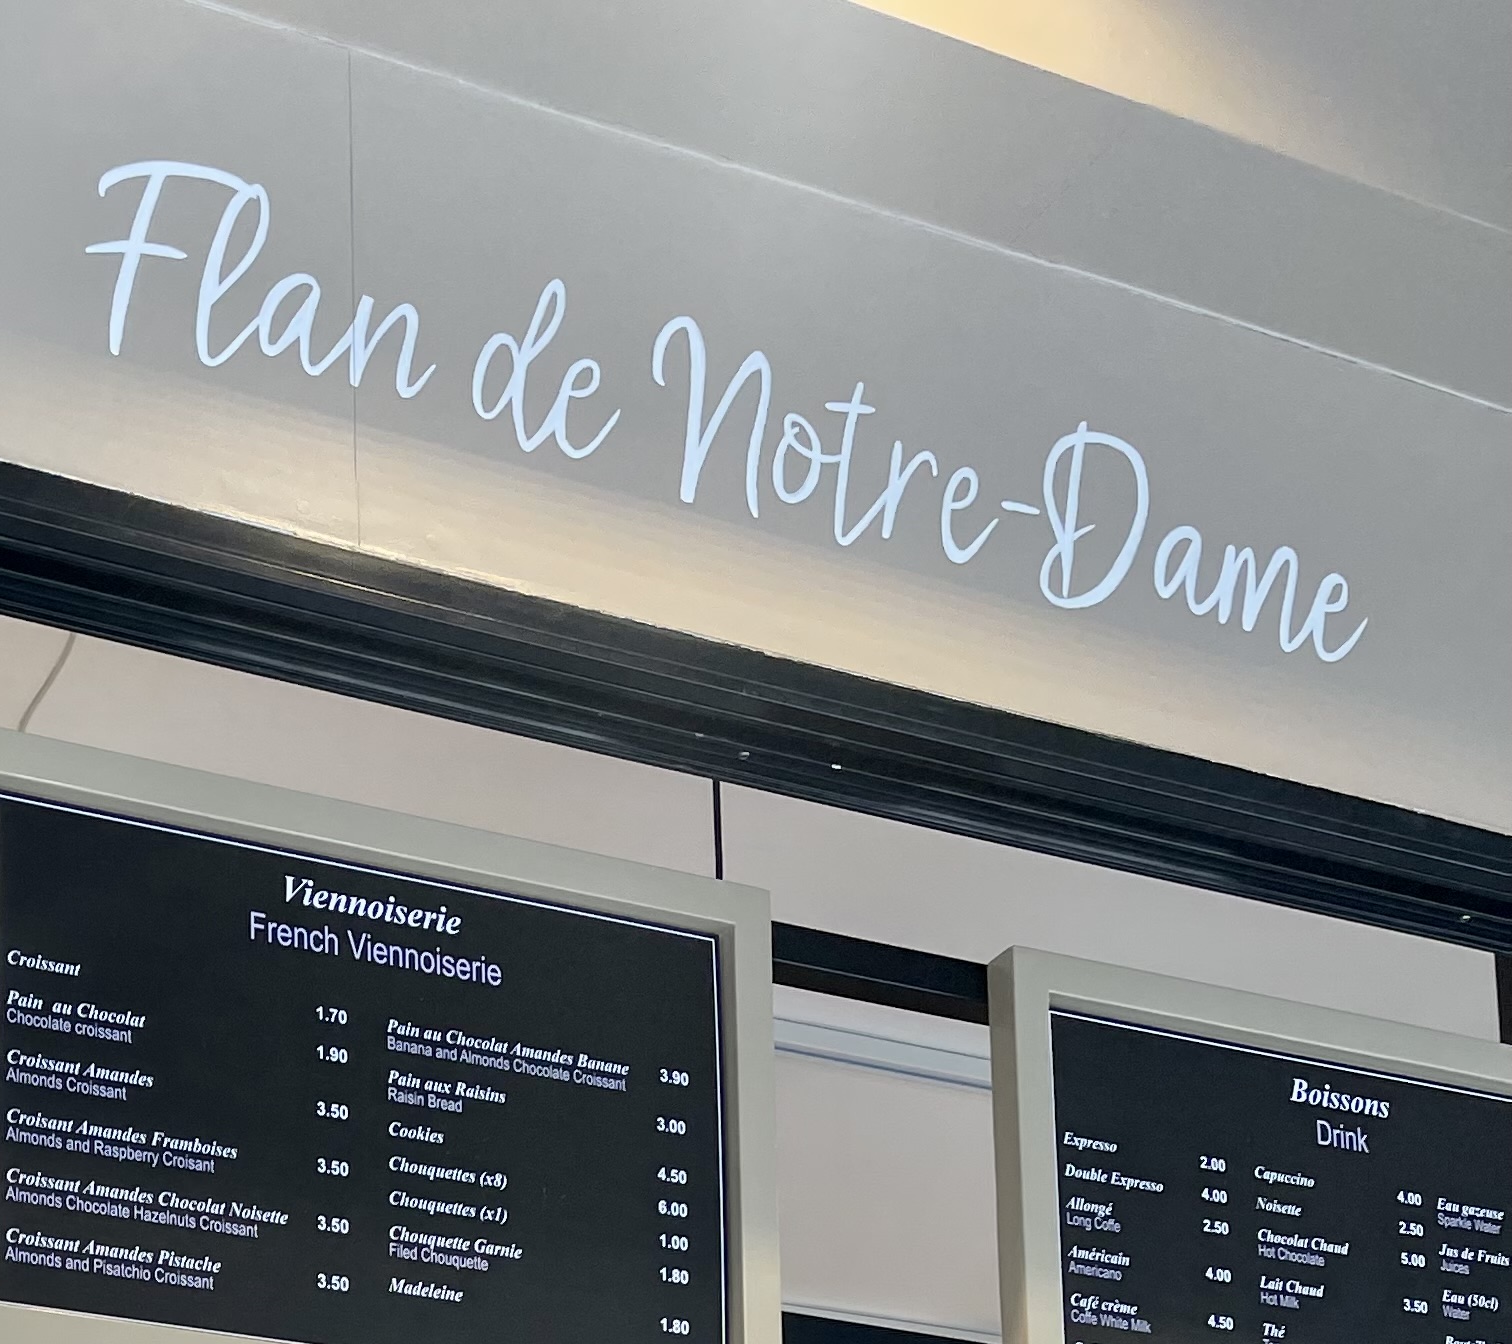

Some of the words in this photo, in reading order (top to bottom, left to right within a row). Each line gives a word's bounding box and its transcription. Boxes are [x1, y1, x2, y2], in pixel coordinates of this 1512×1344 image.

[85, 160, 437, 399] Flan
[473, 278, 620, 459] de
[652, 316, 1368, 662] Notre-Dame
[284, 874, 461, 935] Viennoiserie
[250, 910, 338, 955] French
[346, 929, 502, 986] Viennoiserie
[7, 949, 80, 976] Croissant
[6, 989, 43, 1010] Pain
[51, 1001, 72, 1015] au
[76, 1002, 145, 1028] Chocolat
[315, 1005, 347, 1024] 1.70
[5, 1007, 71, 1032] Chocolate
[74, 1022, 132, 1044] croissant
[316, 1044, 348, 1063] 1.90
[386, 1018, 420, 1037] Pain
[423, 1029, 442, 1042] au
[445, 1029, 508, 1054] Chocolat
[509, 1041, 574, 1065] Amandes
[576, 1052, 629, 1075] Banane
[6, 1048, 80, 1075] Croissant
[81, 1062, 154, 1087] Amandes
[659, 1067, 689, 1086] 3.90
[387, 1069, 420, 1089] Pain
[423, 1079, 451, 1094] aux
[454, 1081, 506, 1103] Raisins
[1289, 1077, 1390, 1118] Boissons
[316, 1100, 348, 1120] 3.50
[387, 1086, 424, 1106] Raisin
[427, 1093, 462, 1112] Bread
[6, 1107, 73, 1133] Croisant
[74, 1119, 147, 1144] Amandes
[150, 1130, 237, 1159] Framboises
[387, 1121, 444, 1144] Cookies
[656, 1116, 686, 1135] 3.00
[1316, 1118, 1369, 1153] Drink
[1062, 1131, 1117, 1152] Expresso
[317, 1157, 349, 1177] 3.50
[388, 1155, 476, 1183] Chouquettes
[479, 1170, 507, 1191] (x8)
[656, 1166, 687, 1184] 4.50
[1199, 1155, 1226, 1172] 2.00
[1063, 1163, 1108, 1183] Double
[1109, 1171, 1164, 1192] Expresso
[1253, 1165, 1315, 1187] Capuccino
[1065, 1195, 1113, 1217] Allongé
[1200, 1187, 1227, 1204] 4.00
[1255, 1196, 1302, 1216] Noisette
[388, 1190, 476, 1217] Chouquettes
[479, 1205, 507, 1225] (x1)
[657, 1199, 688, 1217] 6.00
[1202, 1218, 1229, 1235] 2.50
[5, 1227, 80, 1252] Croissant
[81, 1239, 154, 1263] Amandes
[157, 1249, 221, 1273] Pistache
[388, 1224, 470, 1251] Chouquette
[473, 1238, 522, 1259] Garnie
[658, 1233, 688, 1251] 1.00
[1257, 1227, 1309, 1249] Chocolat
[1310, 1237, 1349, 1255] Chaud
[1066, 1244, 1130, 1266] Américain
[1437, 1242, 1459, 1258] Jus
[1460, 1246, 1474, 1260] de
[1476, 1248, 1510, 1266] Fruits
[658, 1266, 689, 1285] 1.80
[1259, 1275, 1284, 1291] Lait
[1285, 1279, 1324, 1297] Chaud
[388, 1277, 463, 1302] Madeleine
[1441, 1288, 1465, 1305] Eau
[1466, 1293, 1499, 1312] (50cl)
[1069, 1292, 1099, 1309] Café
[1100, 1298, 1138, 1315] crème
[659, 1317, 690, 1335] 1.80
